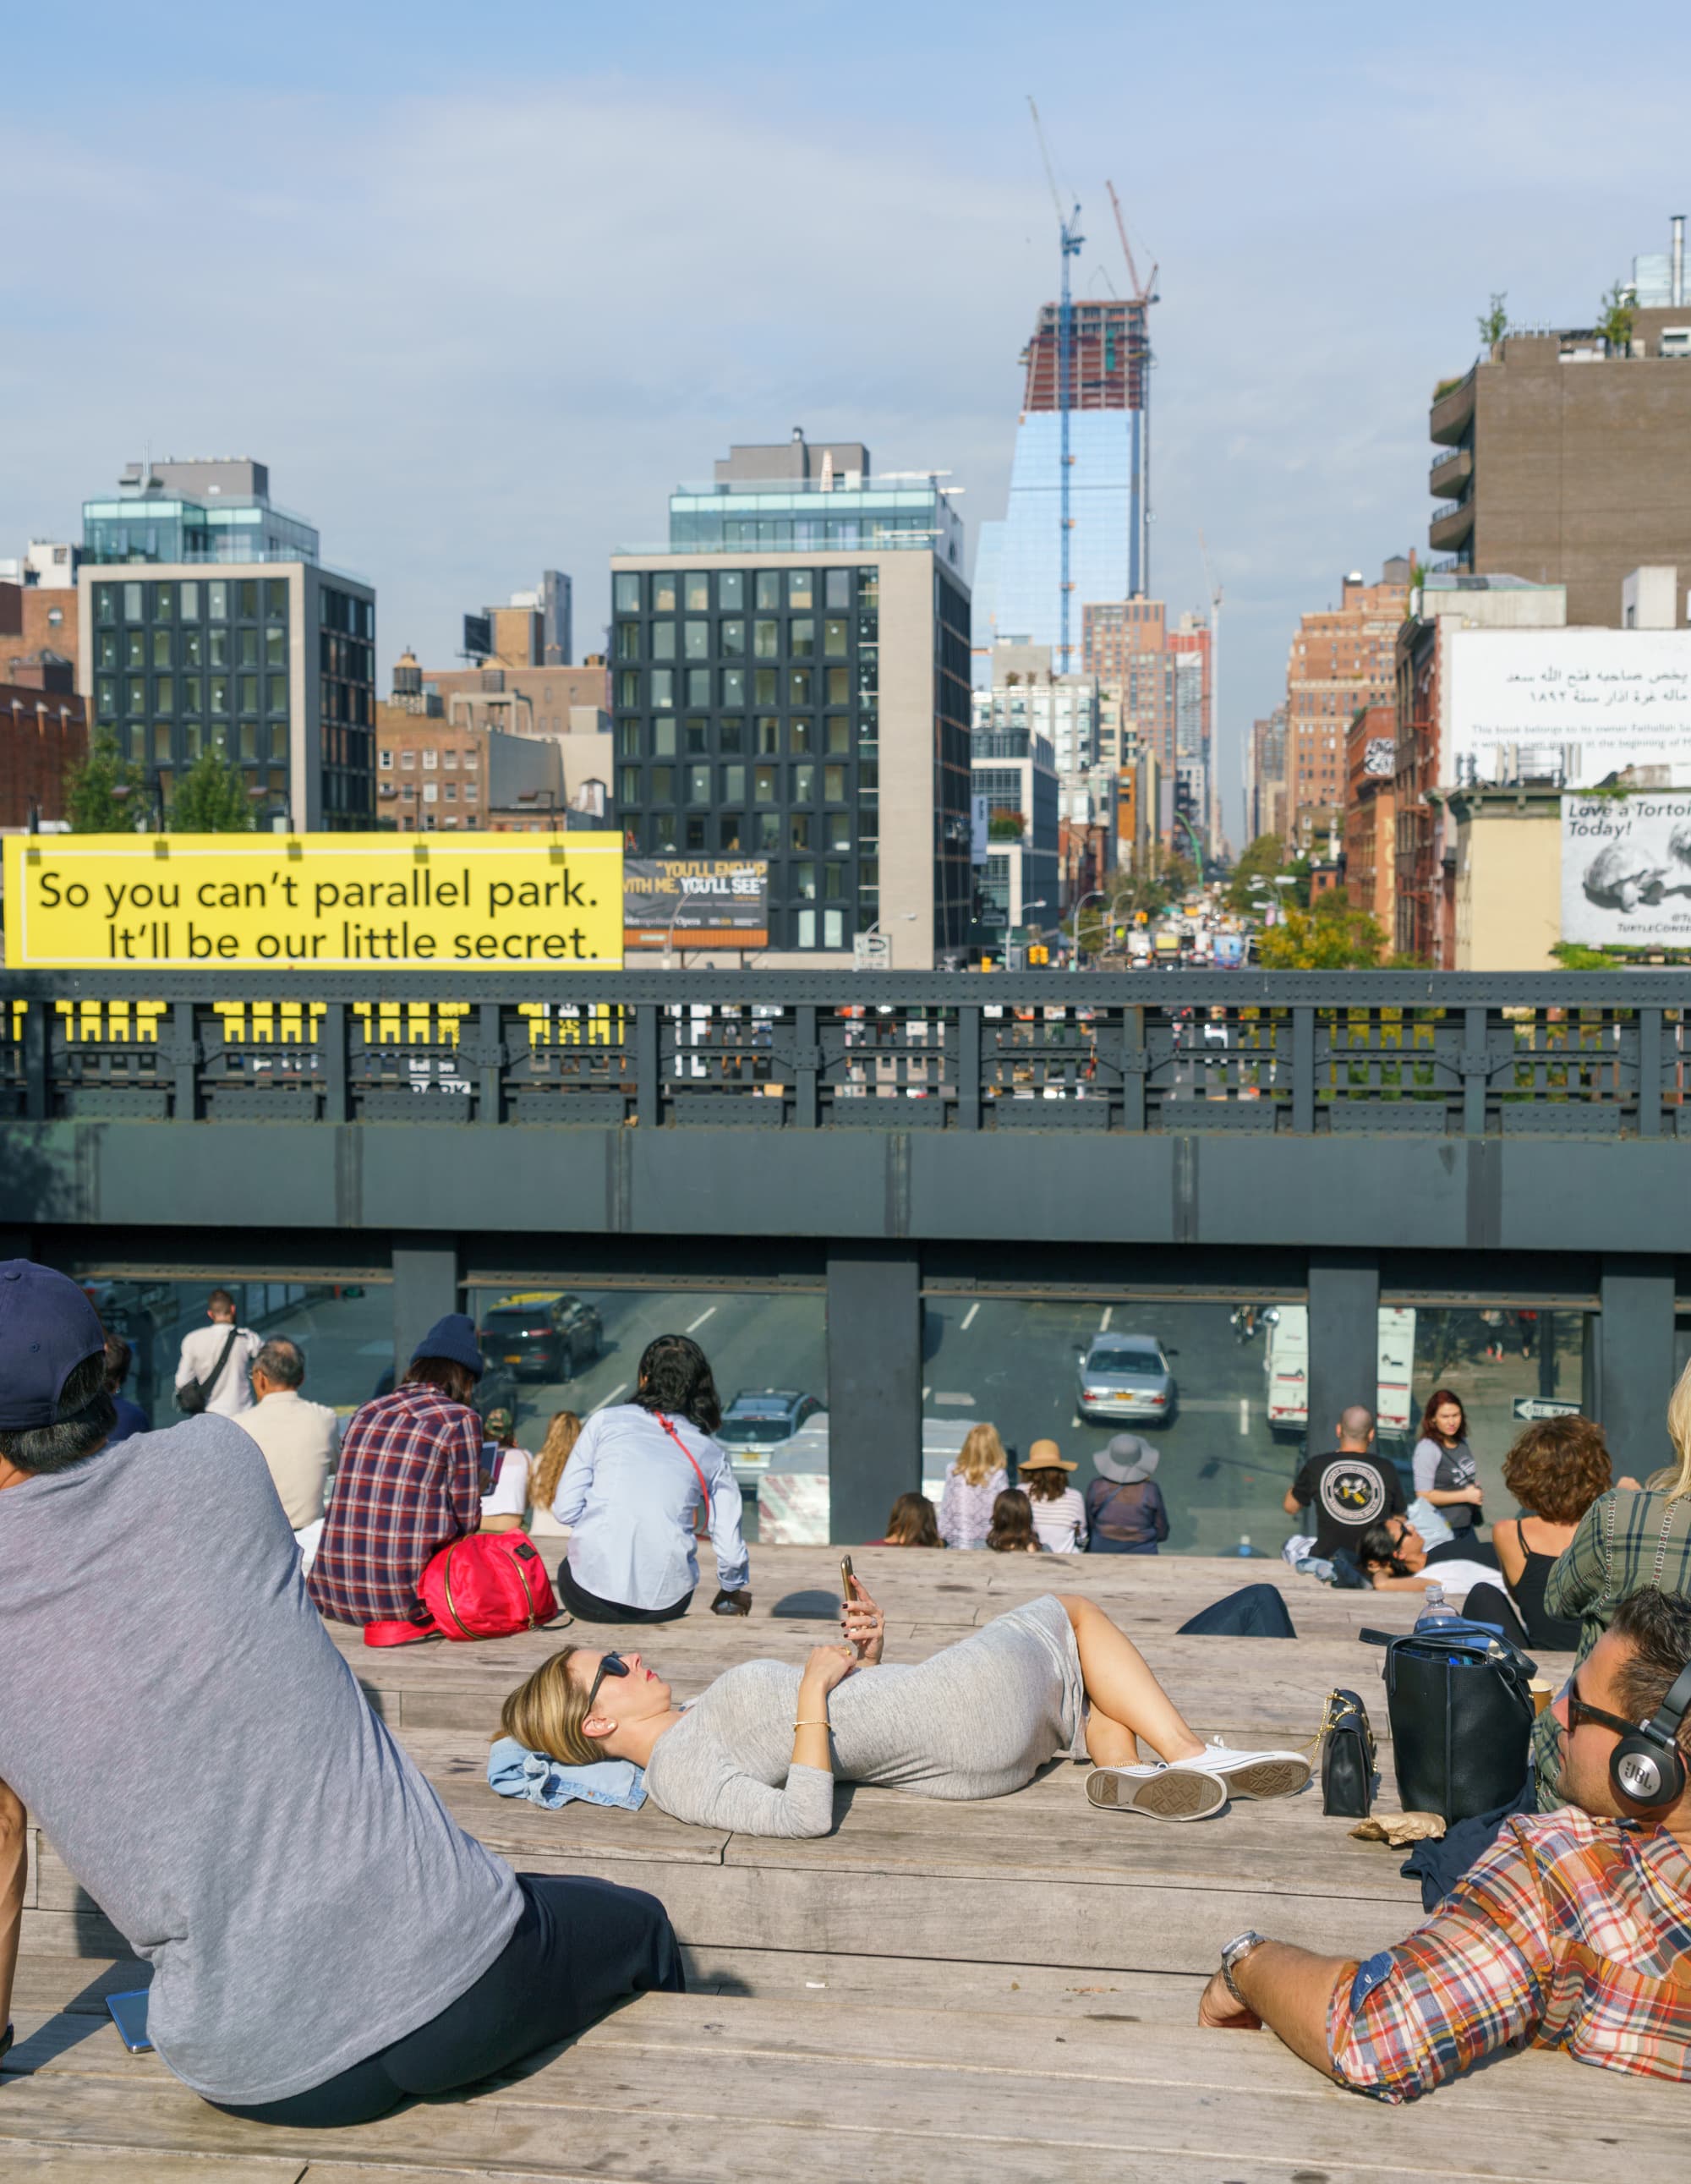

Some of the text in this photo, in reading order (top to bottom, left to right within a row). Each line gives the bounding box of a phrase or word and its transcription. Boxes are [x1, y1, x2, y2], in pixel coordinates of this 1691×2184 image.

[1569, 821, 1632, 840] Today!
[40, 868, 598, 918] So you can't parallel park.
[110, 921, 598, 959] It'll be our little secret.
[1524, 1405, 1545, 1416] ONE
[1624, 1764, 1653, 1791] JBL
